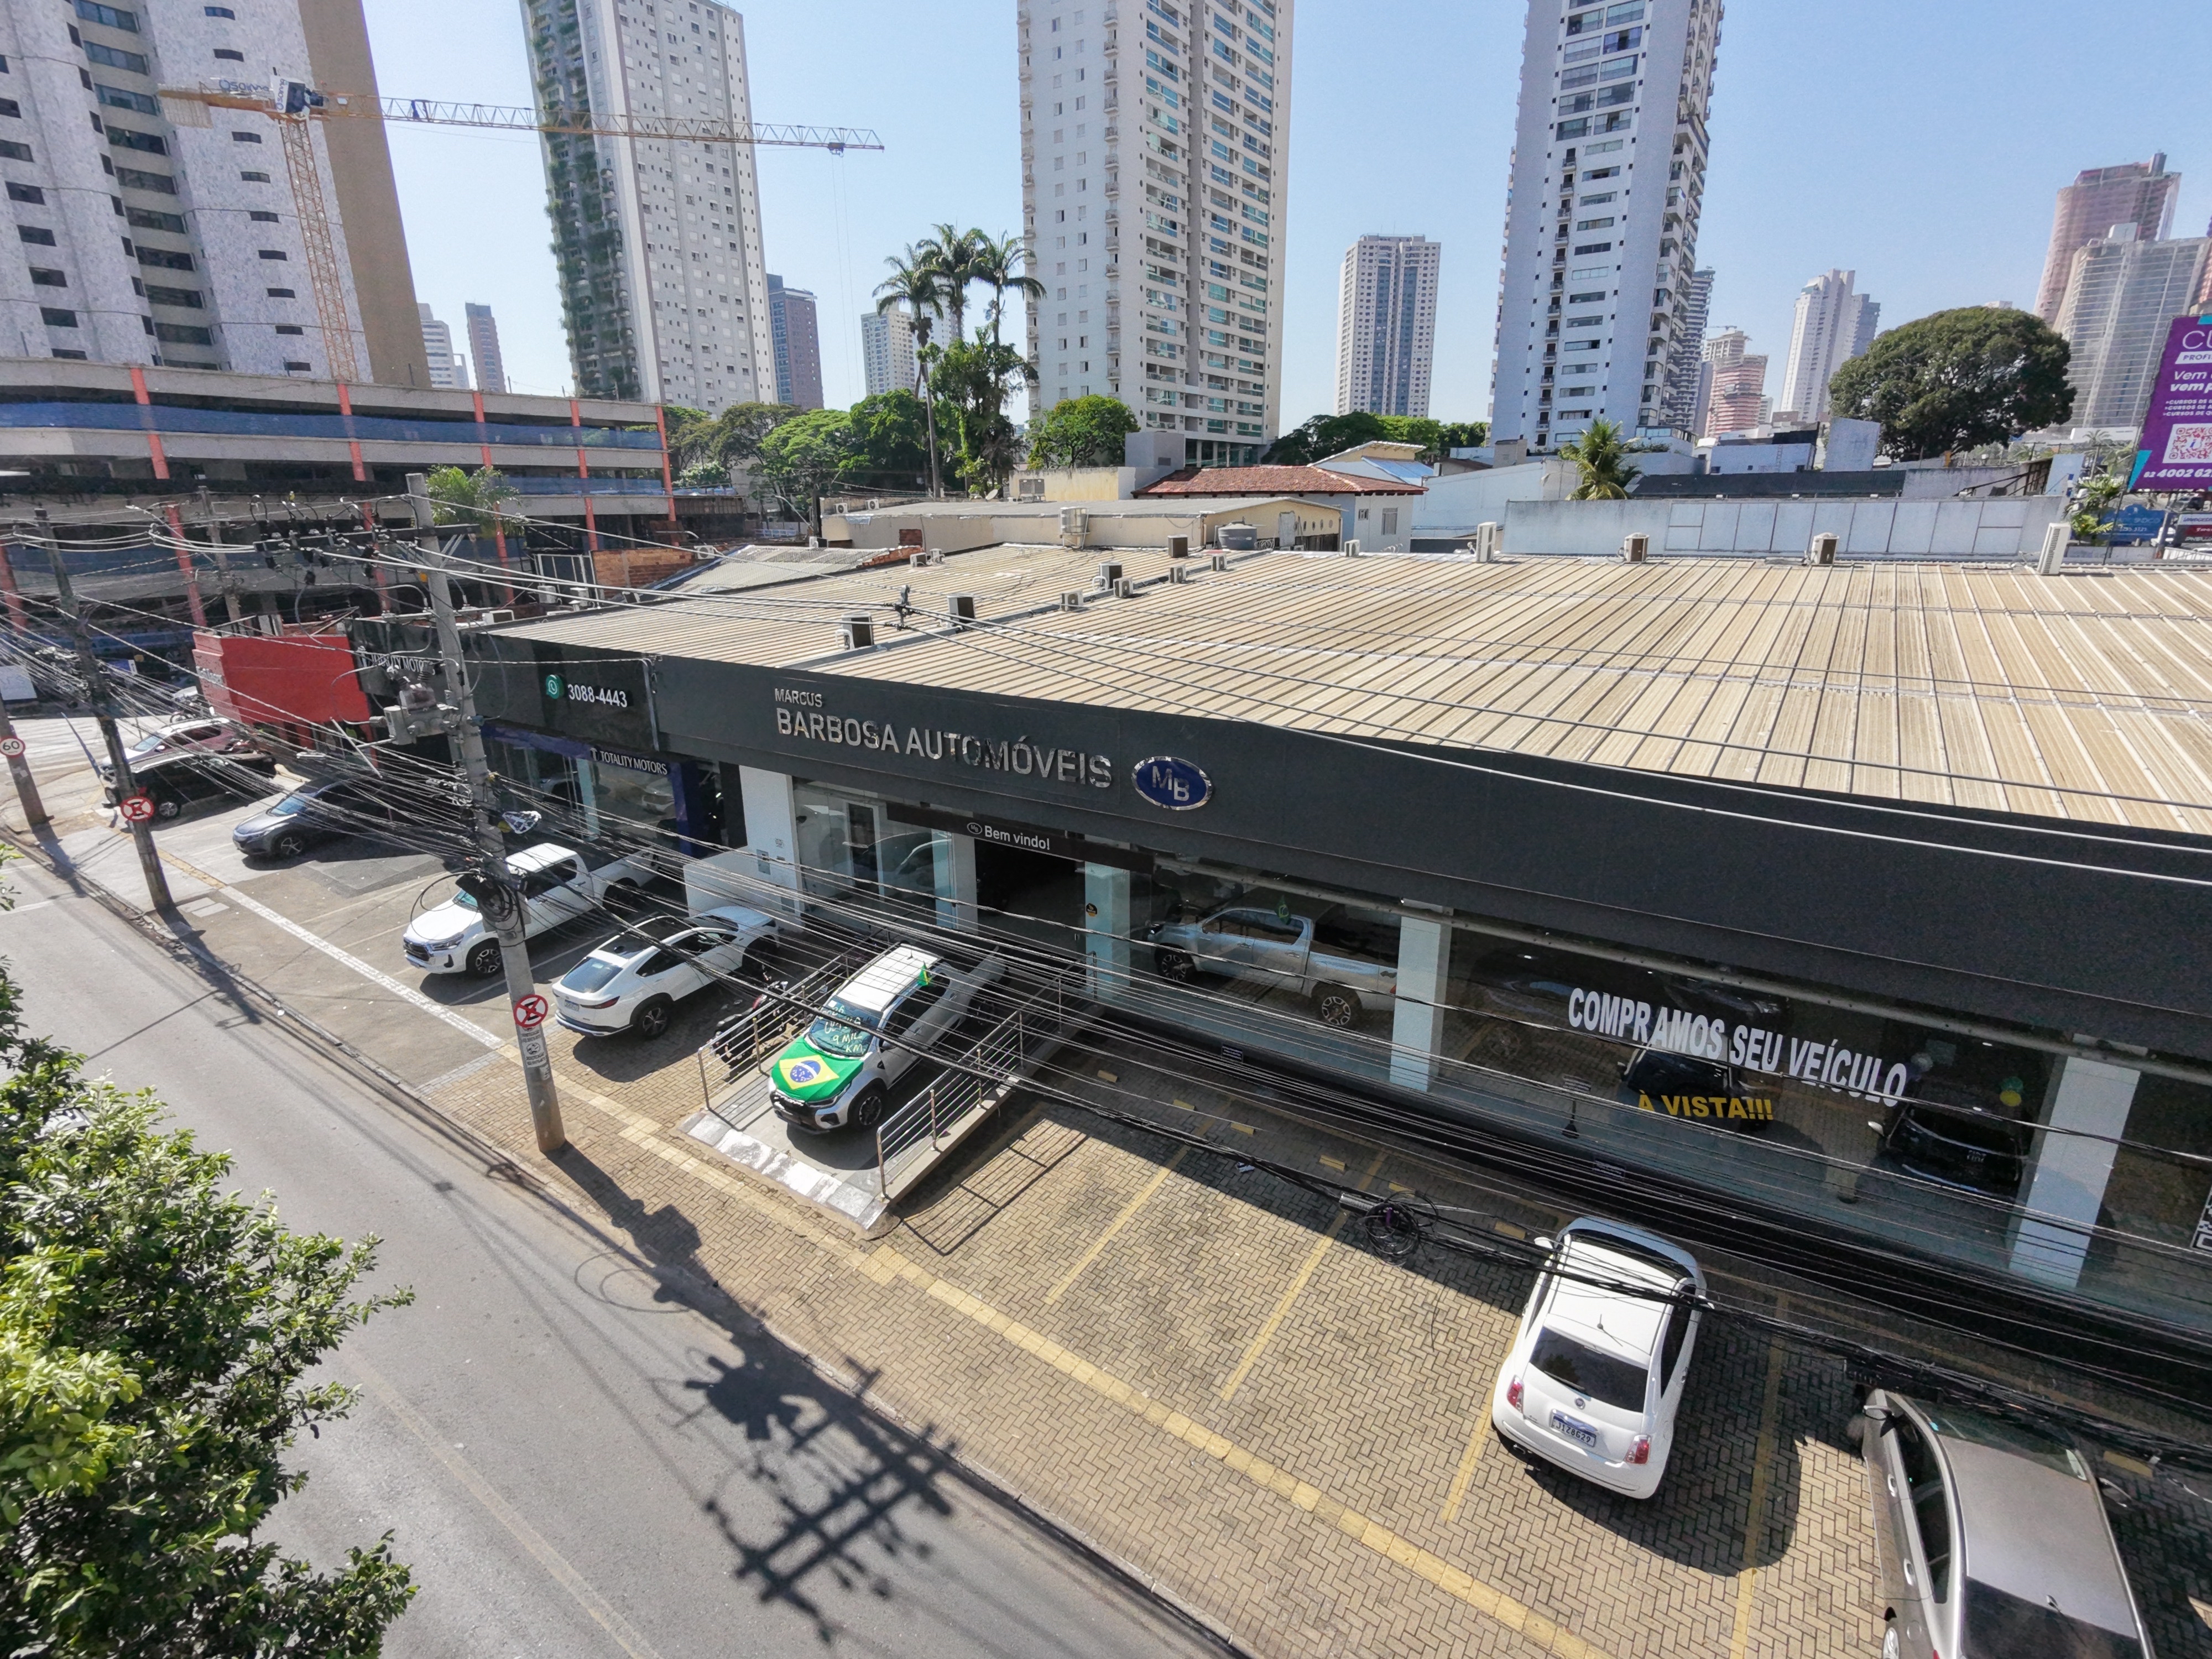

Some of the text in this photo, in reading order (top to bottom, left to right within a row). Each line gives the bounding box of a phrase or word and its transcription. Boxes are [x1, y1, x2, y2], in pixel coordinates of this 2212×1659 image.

[2174, 371, 2208, 380] Vem
[2170, 383, 2205, 392] vem
[2157, 468, 2194, 478] 4002
[2194, 468, 2212, 478] 62
[567, 684, 628, 708] 3088-4443
[774, 688, 823, 708] MARCUS
[2, 740, 20, 751] 60
[776, 707, 1112, 789] BARBOSA AUTOMÓVEIS
[599, 750, 633, 769] TOTALITY
[633, 758, 668, 775] MOTORS
[1152, 765, 1190, 801] MB
[984, 825, 1011, 842] Bem
[1013, 832, 1050, 851] vindo!
[832, 1032, 863, 1045] 9 MIL
[846, 1043, 864, 1055] KM
[1568, 988, 1907, 1108] COMPRAMOS SEU VEÍCULO
[1637, 1089, 1774, 1120] À VISTA!!!
